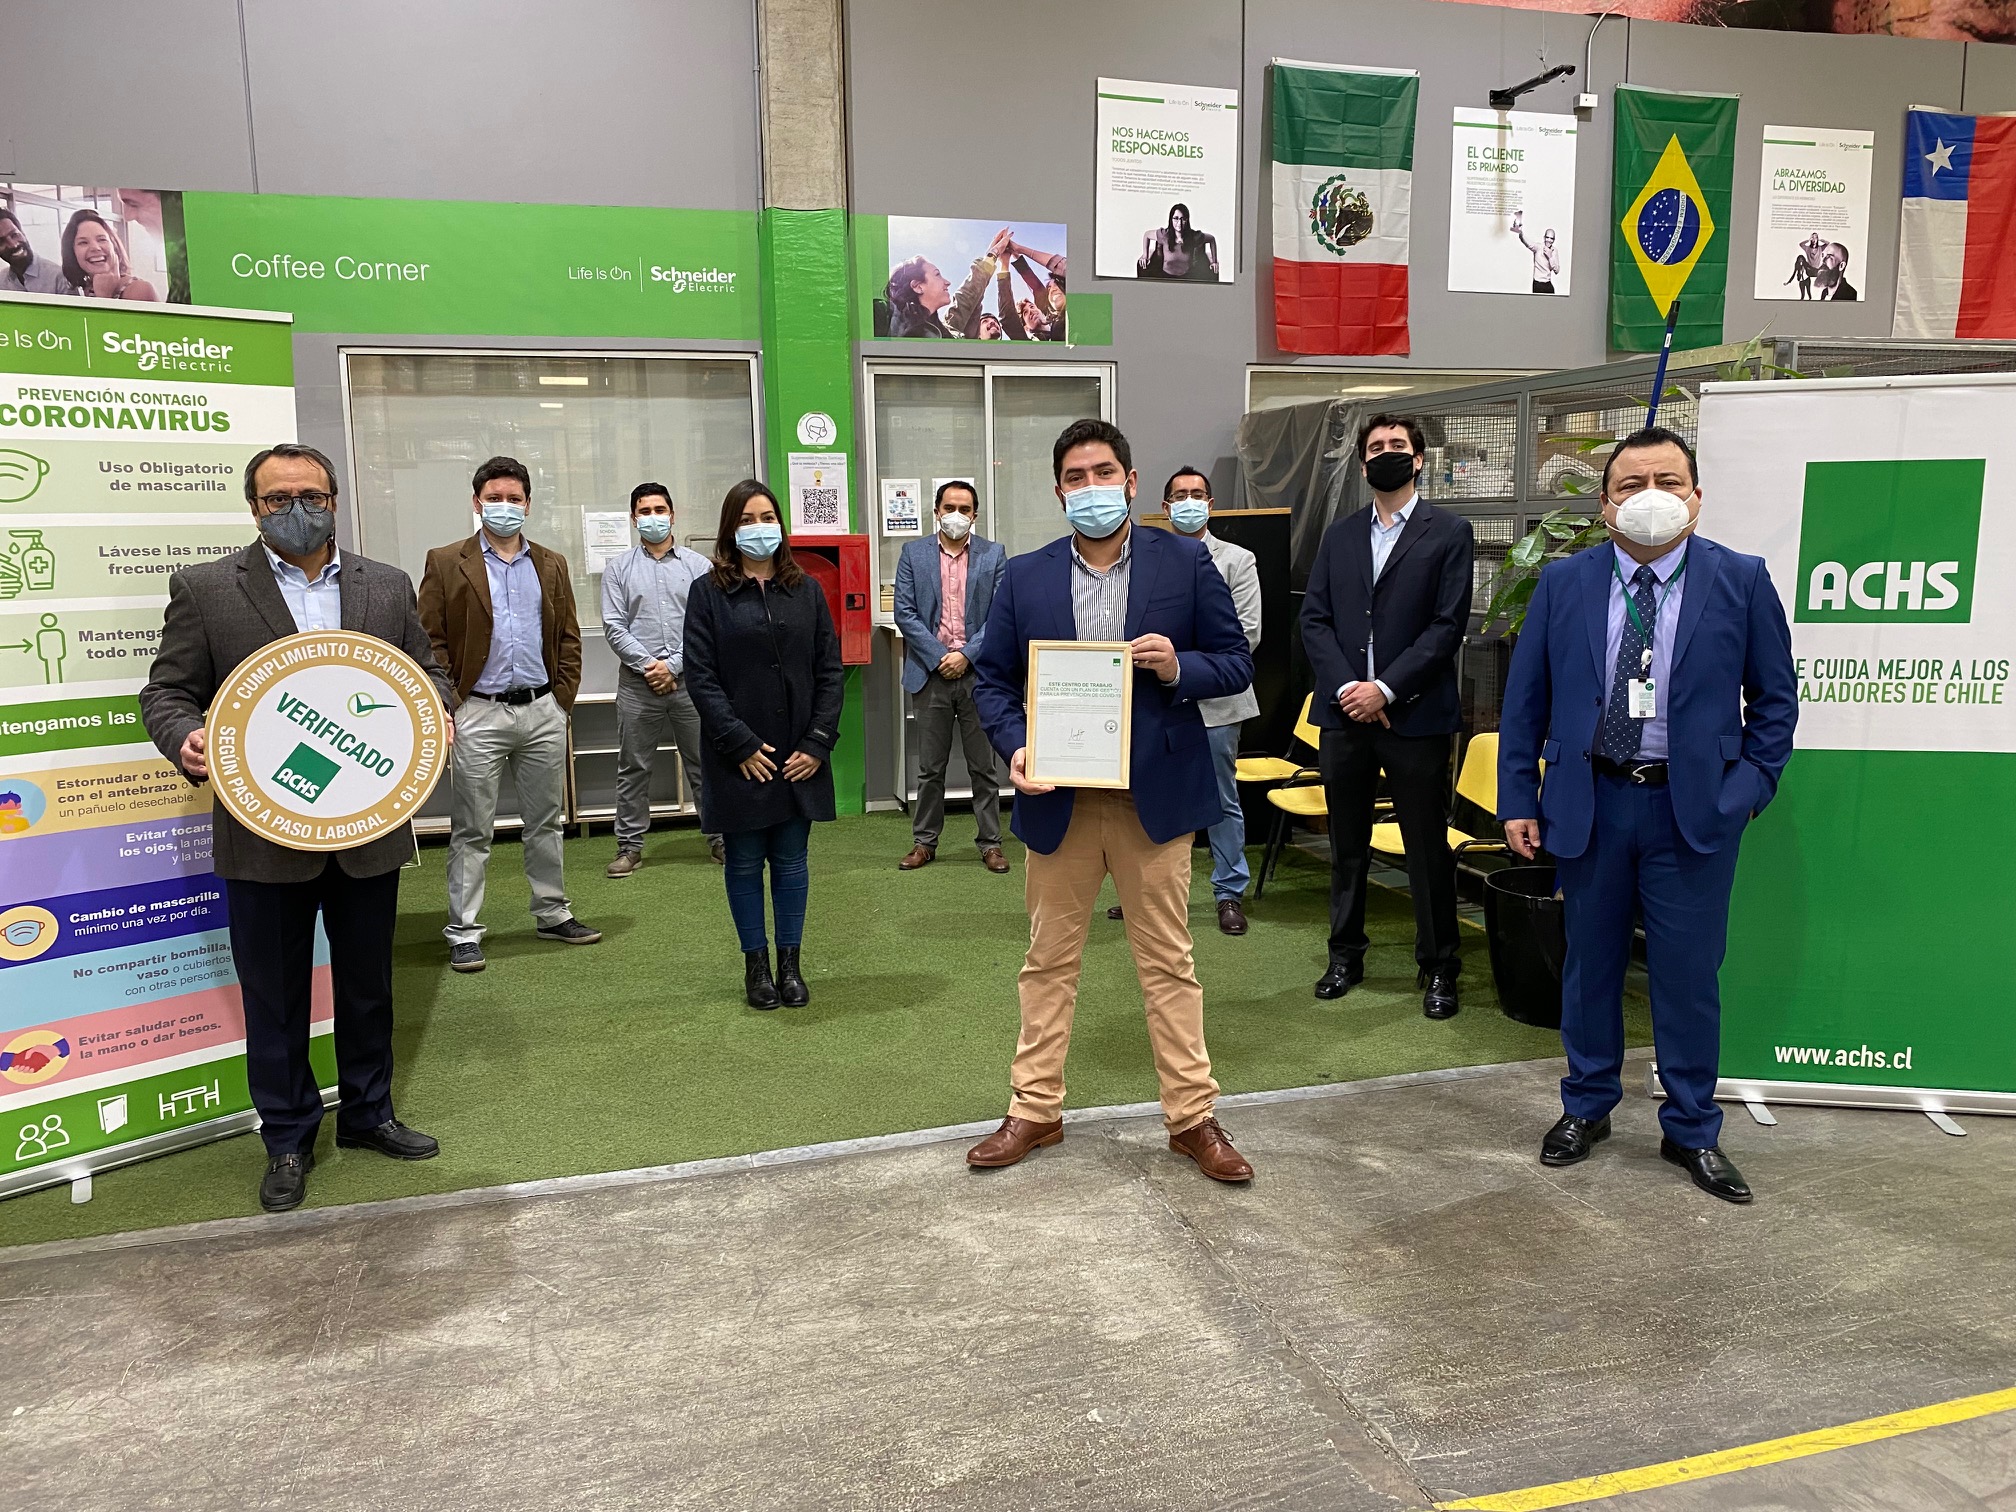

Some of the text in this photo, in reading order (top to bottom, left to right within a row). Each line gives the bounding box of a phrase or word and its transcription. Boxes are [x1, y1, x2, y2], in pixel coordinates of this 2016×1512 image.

[1194, 100, 1222, 109] Schneider
[1112, 126, 1190, 142] NOS HACEMOS
[1538, 126, 1563, 134] Schneider
[1112, 139, 1204, 159] RESPONSABLES
[1467, 146, 1525, 161] EL CLIENTE
[1467, 161, 1519, 173] ES PRIMERO
[1774, 168, 1827, 179] ABRAZAMOS
[1772, 179, 1846, 194] LA DIVERSIDAD
[231, 252, 430, 282] Coffee Corner
[568, 265, 632, 280] Life Is On
[650, 265, 737, 283] Schneider
[688, 282, 735, 293] Electric
[15, 330, 32, 348] Is
[37, 329, 71, 350] On
[103, 331, 234, 360] Schneider
[162, 357, 232, 373] Electric
[18, 387, 208, 407] PREVENCIÓN CONTAGIO
[0, 404, 231, 433] CORONAVIRUS
[99, 461, 234, 477] Uso Obligatorio
[110, 479, 227, 492] de mascarilla
[99, 544, 160, 558] Lávese
[166, 545, 193, 557] las
[1808, 560, 1959, 611] ACHS
[86, 647, 127, 659] todo
[1812, 658, 1870, 680] CUIDA
[1877, 658, 1944, 680] MEJOR
[1949, 659, 1963, 680] A
[1971, 659, 2010, 681] LOS
[1799, 681, 2005, 704] AJADORES DE CHILE
[0, 710, 137, 738] tengamos las
[236, 642, 437, 803] CUMPLIMIENTO ESTÁNDAR ACHS COVID-19
[275, 691, 396, 778] VERIFICADO
[56, 773, 138, 790] Estornudar
[142, 772, 151, 781] o
[57, 794, 86, 804] con
[90, 789, 103, 800] el
[107, 782, 177, 799] antebrazo
[181, 781, 189, 790] o
[218, 726, 388, 840] SEGÚN PASO A PASO LABORAL
[276, 766, 320, 800] ACHS
[59, 793, 197, 818] un pañuelo desechable.
[126, 823, 214, 843] Evitar tocars
[119, 834, 214, 858] los ojos, la nari
[172, 849, 213, 865] y la boc
[69, 890, 220, 924] Cambio de mascarilla
[74, 904, 211, 937] mínimo una vez por día.
[73, 943, 231, 979] No compartir bombilla,
[136, 954, 231, 981] vaso o cubiertos
[125, 970, 232, 997] con otras personas.
[78, 1012, 204, 1047] Evitar saludar con
[80, 1022, 222, 1060] la mano o dar besos.
[1774, 1045, 1912, 1070] www.achs.cl
